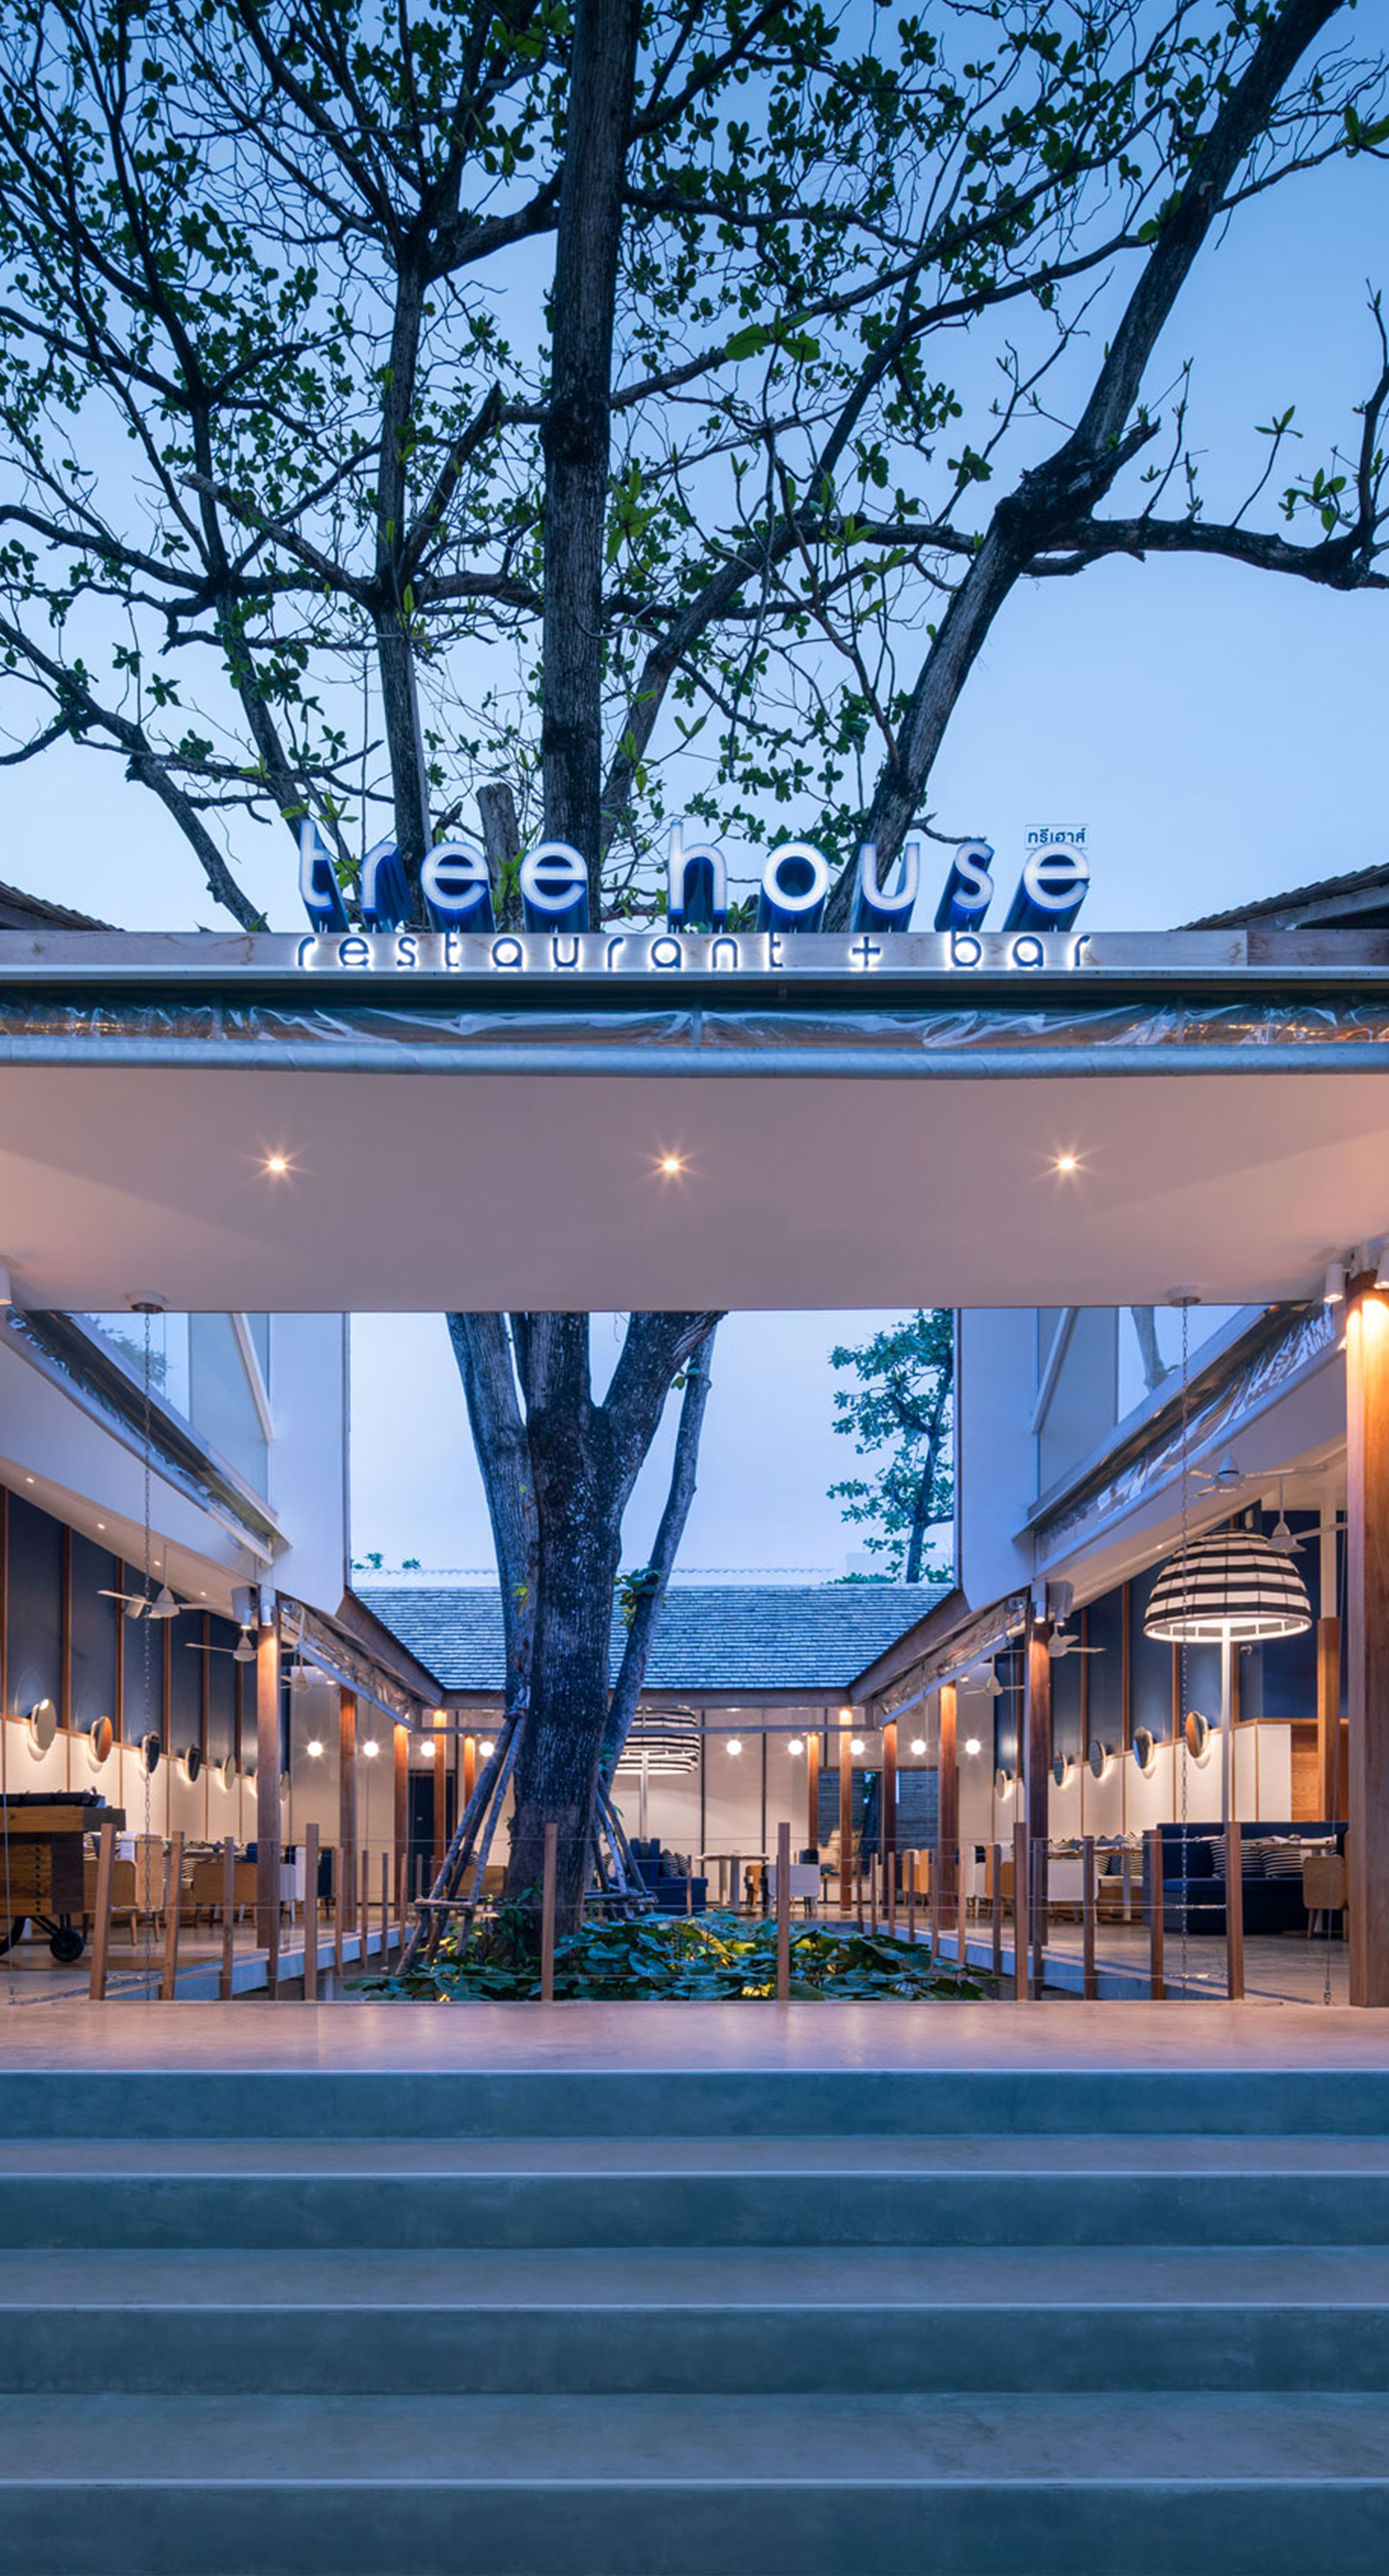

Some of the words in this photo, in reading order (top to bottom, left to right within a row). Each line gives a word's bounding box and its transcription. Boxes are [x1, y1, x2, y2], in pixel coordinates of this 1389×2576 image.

[1027, 827, 1086, 844] ทรีเฮาส์
[299, 819, 590, 913] tree
[667, 821, 1090, 914] house
[297, 932, 784, 968] restaurant
[851, 936, 881, 968] +
[949, 931, 1092, 968] bar
